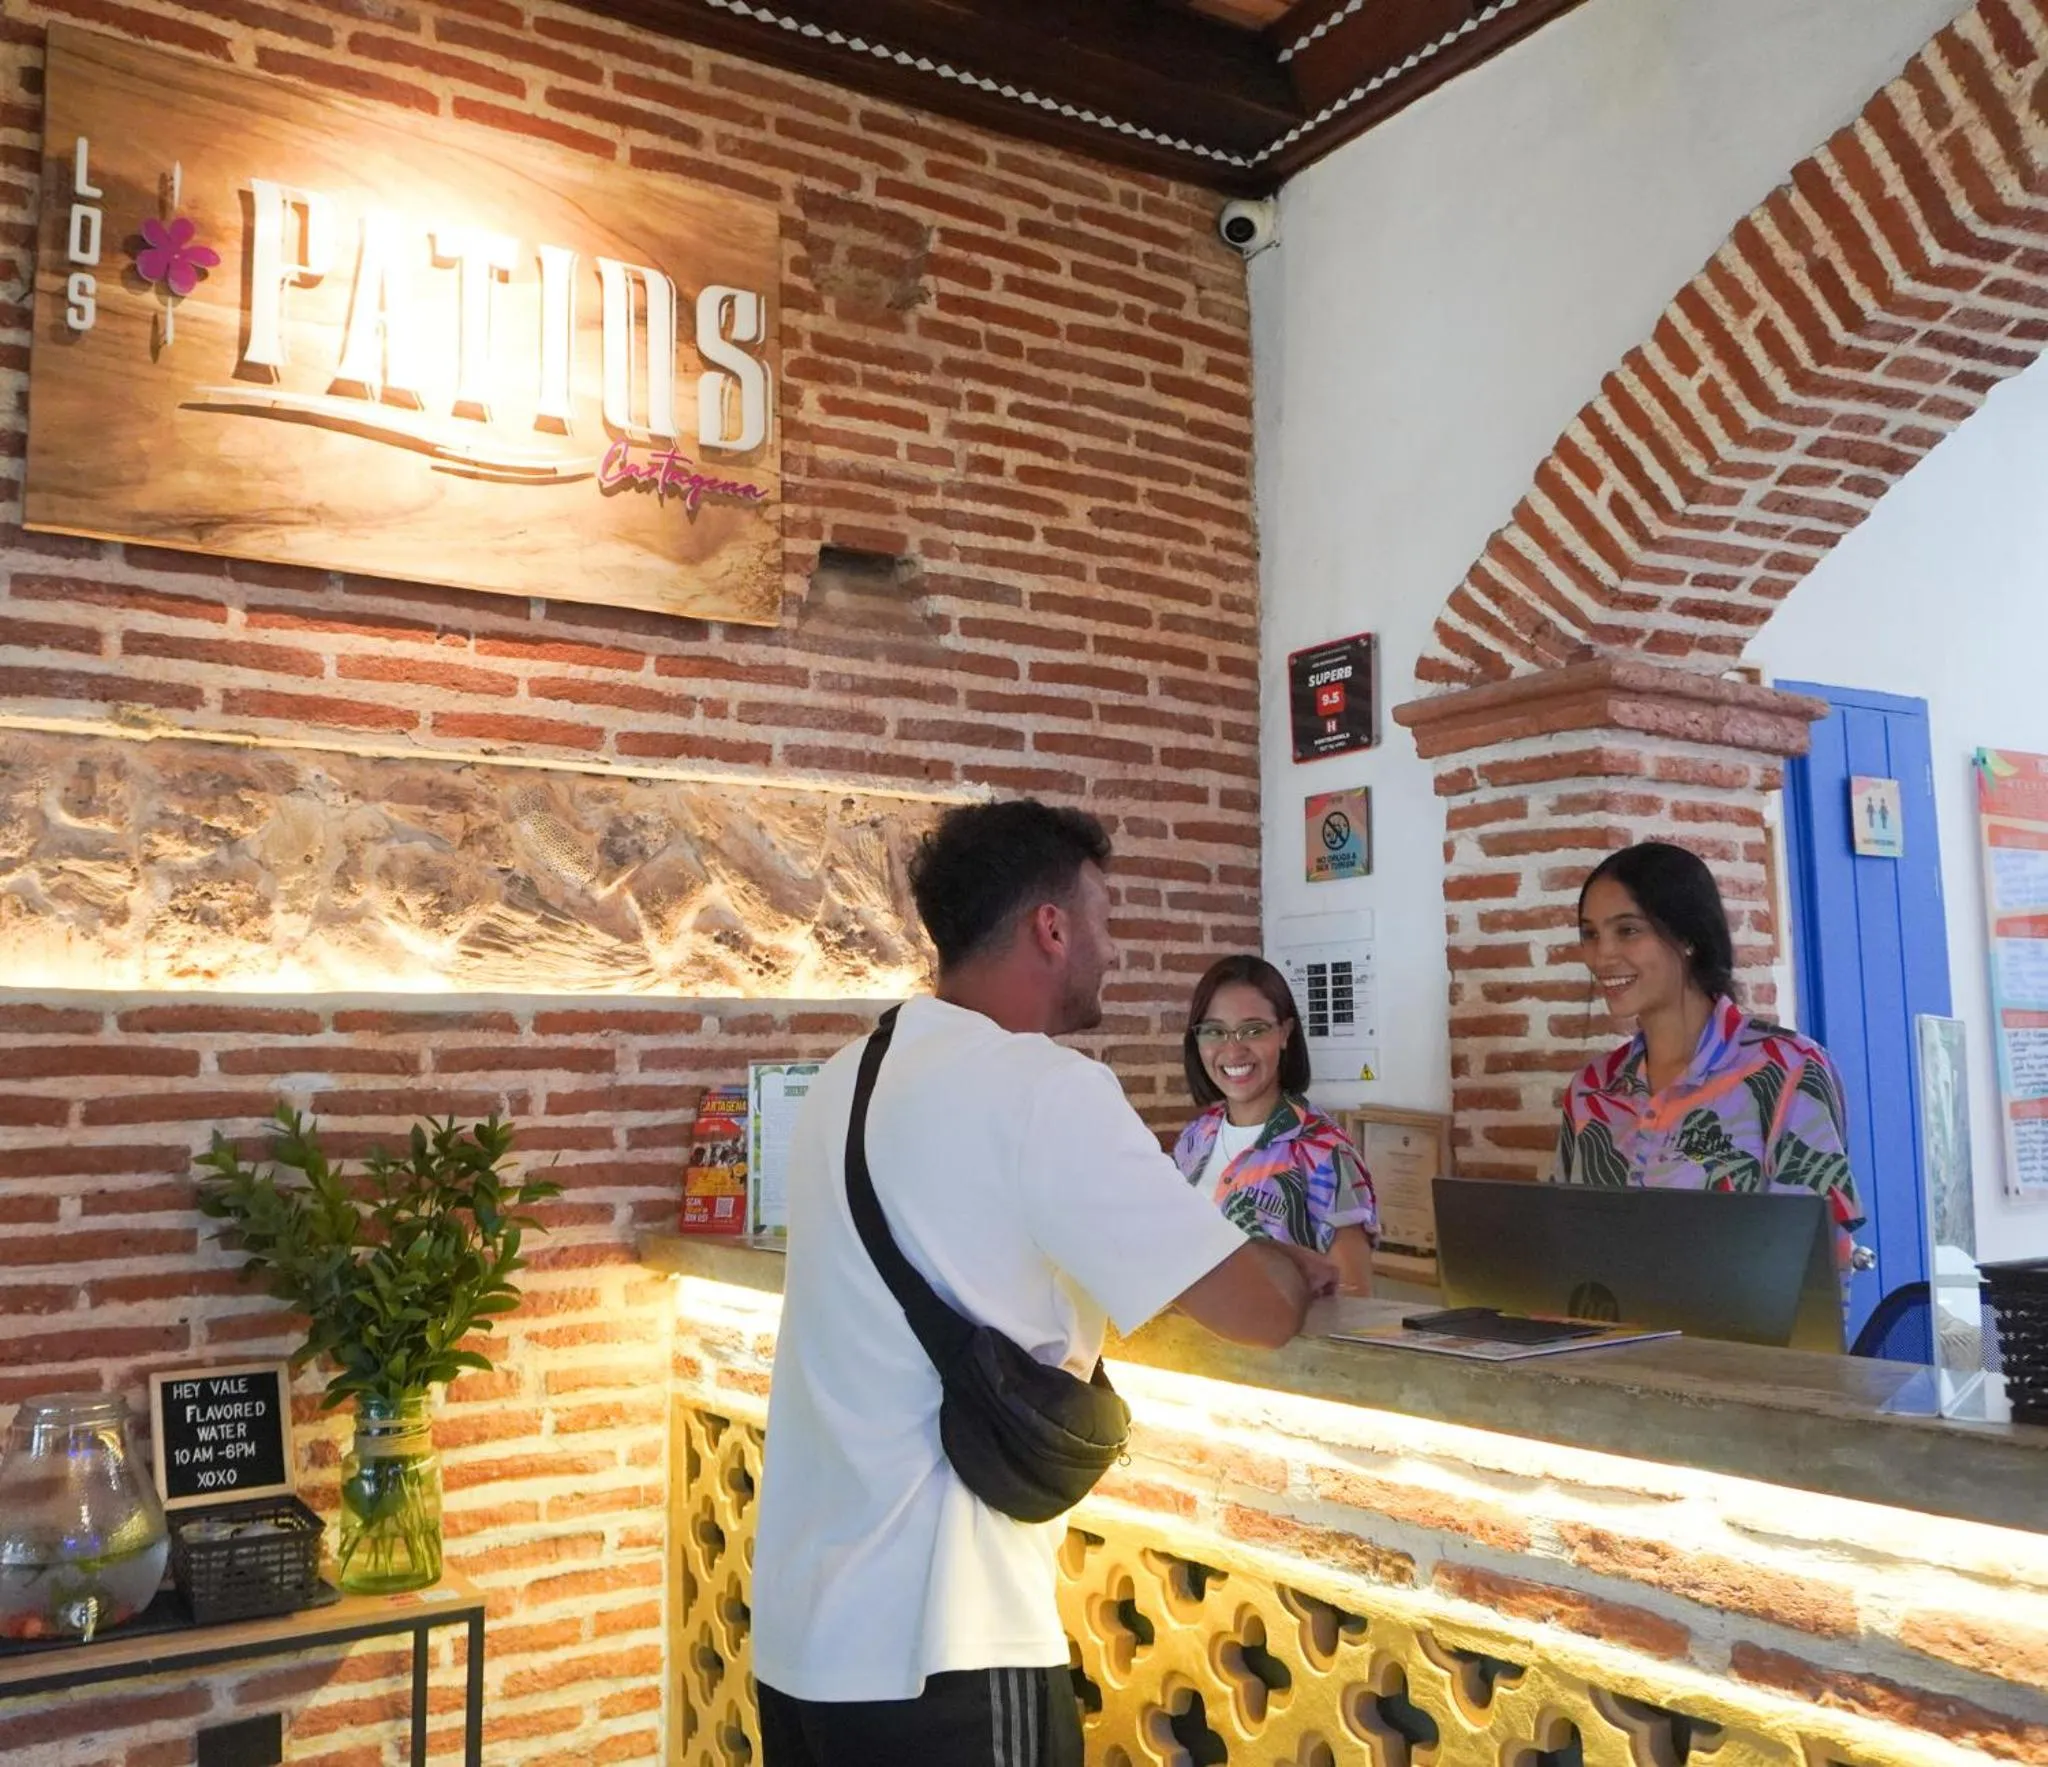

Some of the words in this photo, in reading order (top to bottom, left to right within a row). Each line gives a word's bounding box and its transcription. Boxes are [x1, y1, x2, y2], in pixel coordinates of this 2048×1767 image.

[66, 135, 104, 332] LOS
[243, 177, 773, 454] PATIOS
[598, 437, 769, 508] Cartagena
[1308, 665, 1353, 688] SUPERB
[173, 1382, 201, 1400] HEY
[209, 1378, 248, 1397] VALE
[185, 1401, 266, 1424] FLAVORED
[196, 1422, 247, 1442] WATER
[197, 1468, 238, 1488] XOXO
